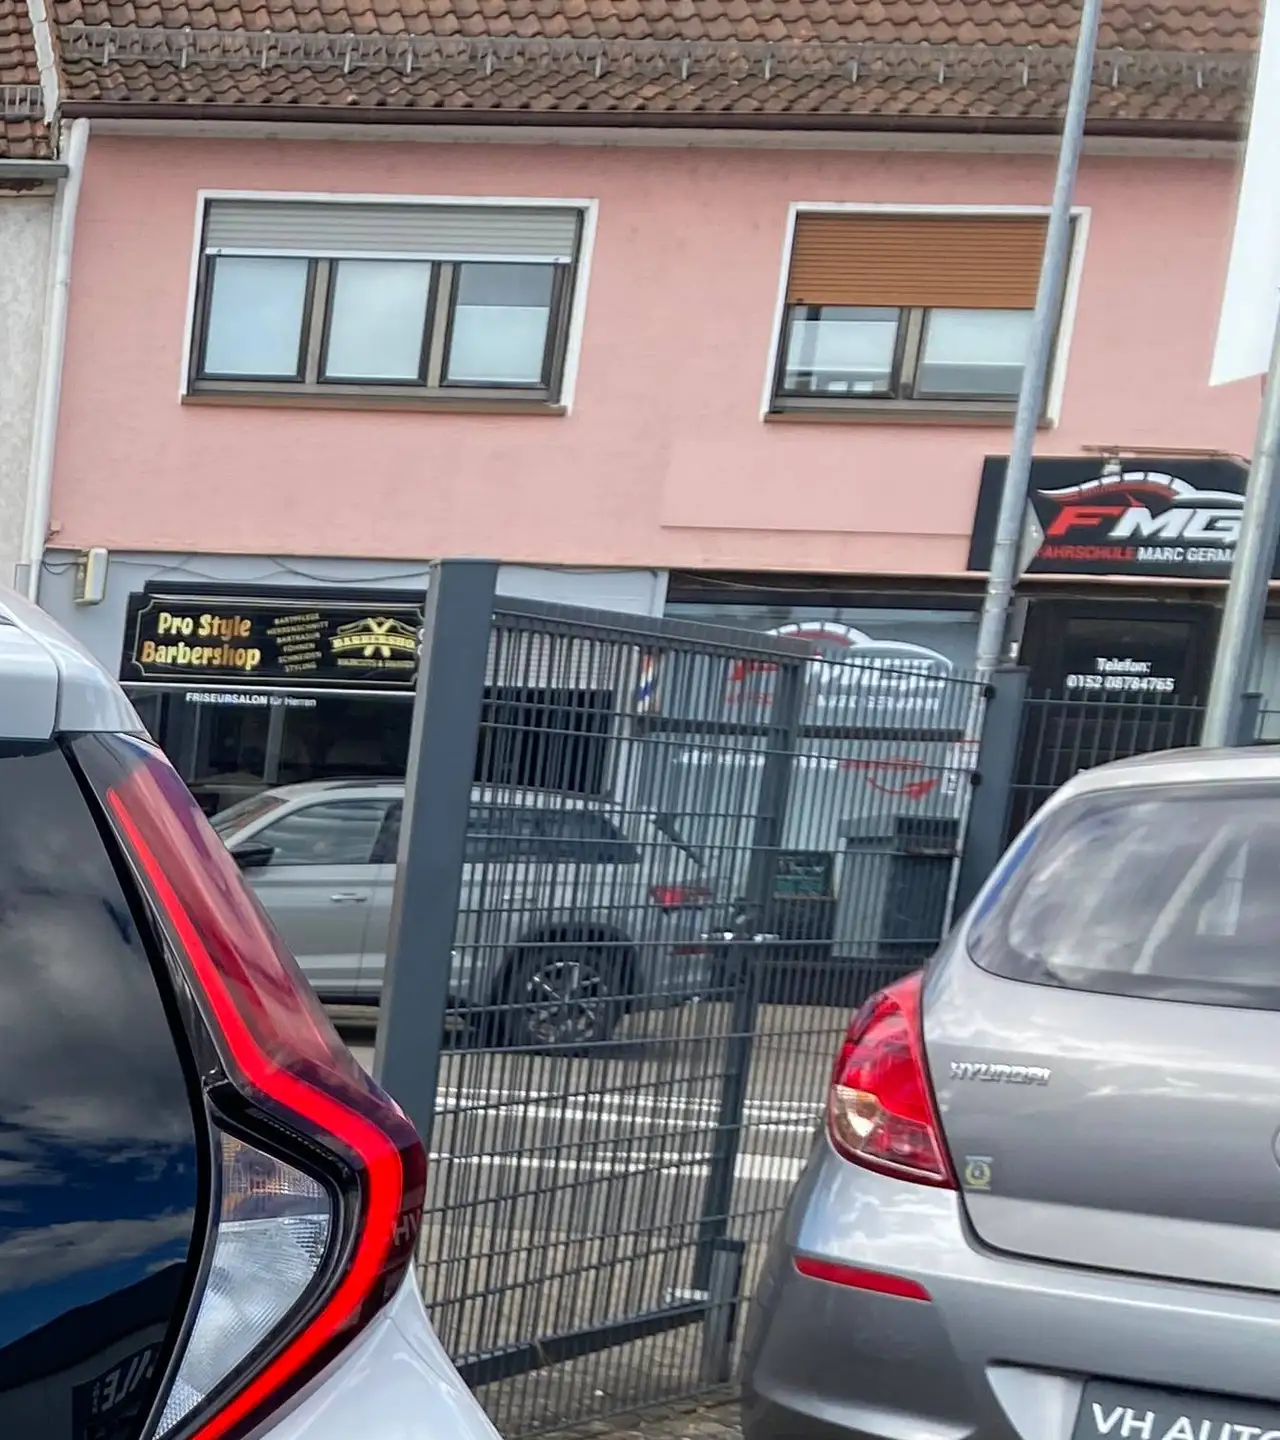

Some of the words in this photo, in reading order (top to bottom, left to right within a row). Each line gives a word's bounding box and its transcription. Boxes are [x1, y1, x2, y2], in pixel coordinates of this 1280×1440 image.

[1135, 545, 1184, 560] MARC
[156, 612, 194, 636] Pro
[197, 613, 252, 641] Style
[141, 641, 261, 671] Barbershop
[185, 692, 268, 705] FRISEURSALON
[1092, 1402, 1156, 1440] VH
